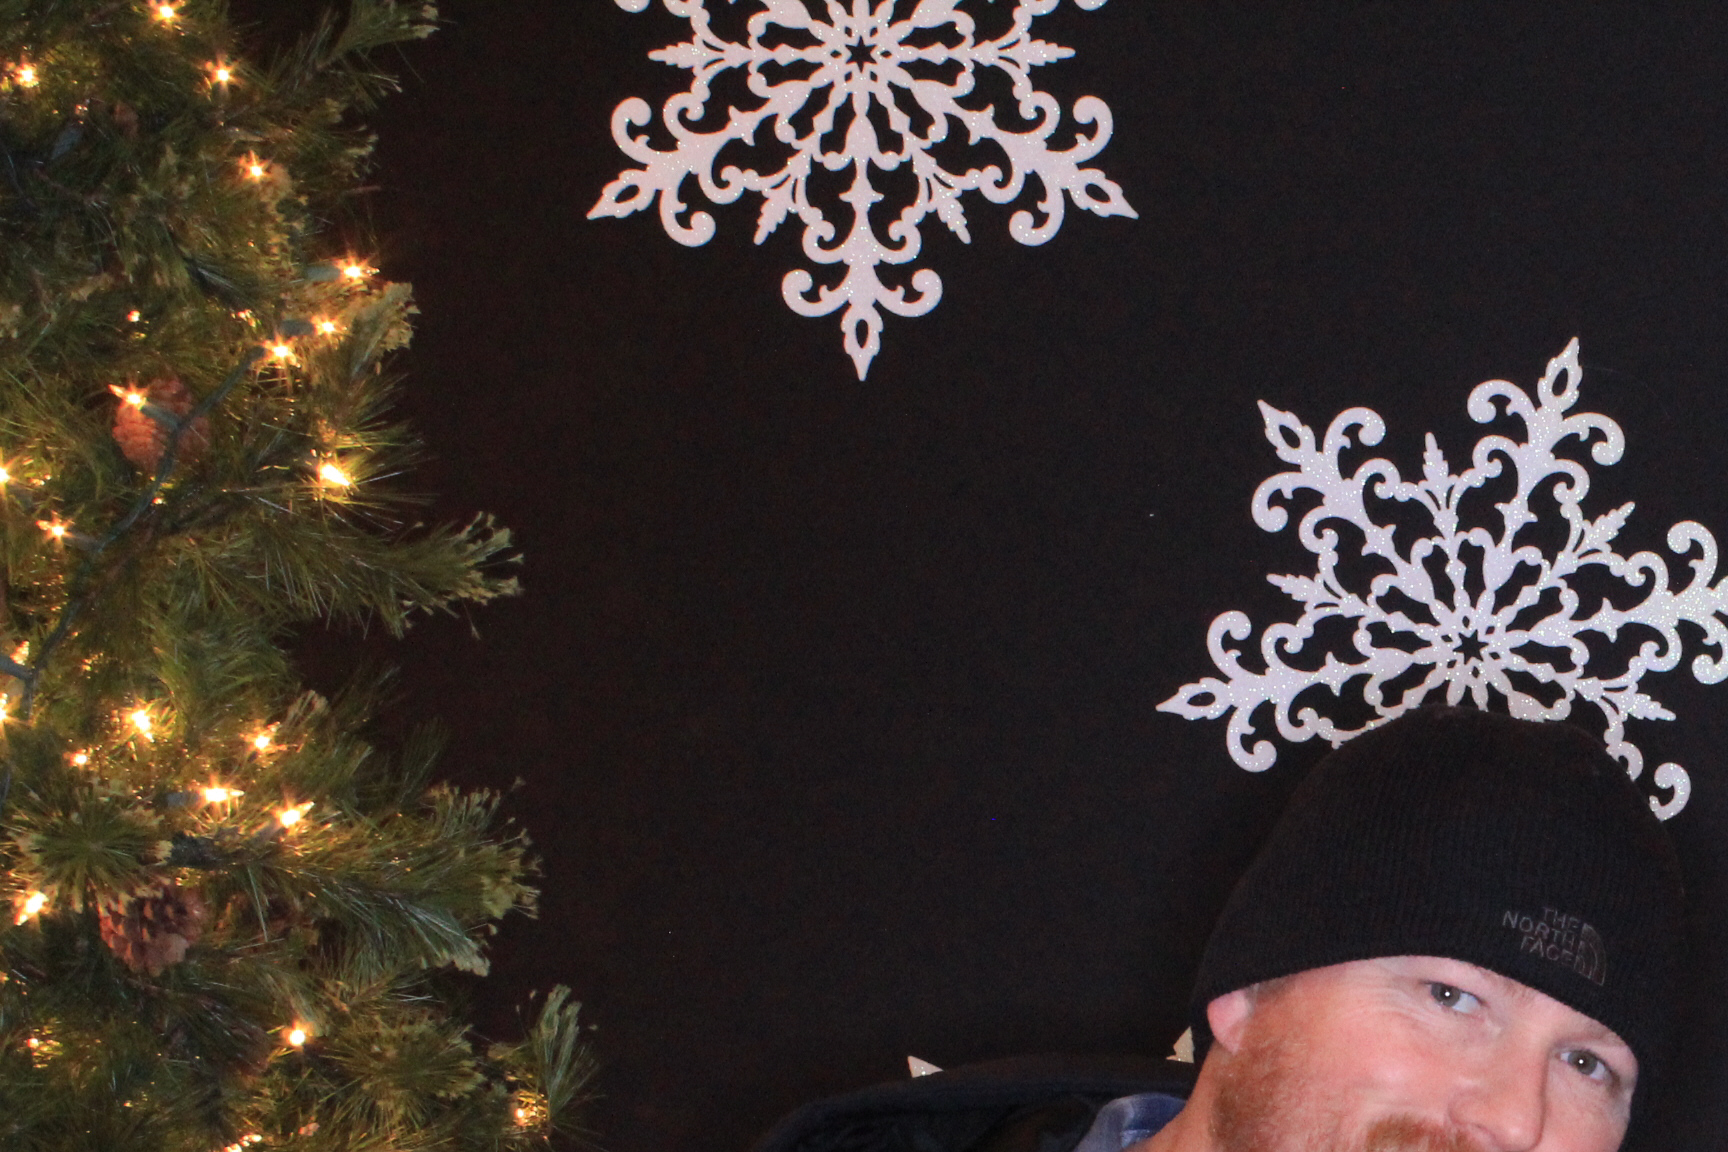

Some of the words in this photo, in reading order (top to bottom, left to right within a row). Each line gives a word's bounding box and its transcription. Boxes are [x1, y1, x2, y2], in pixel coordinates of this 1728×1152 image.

[1502, 910, 1577, 949] NORTH
[1543, 906, 1581, 929] THE
[1520, 935, 1575, 963] FACE
